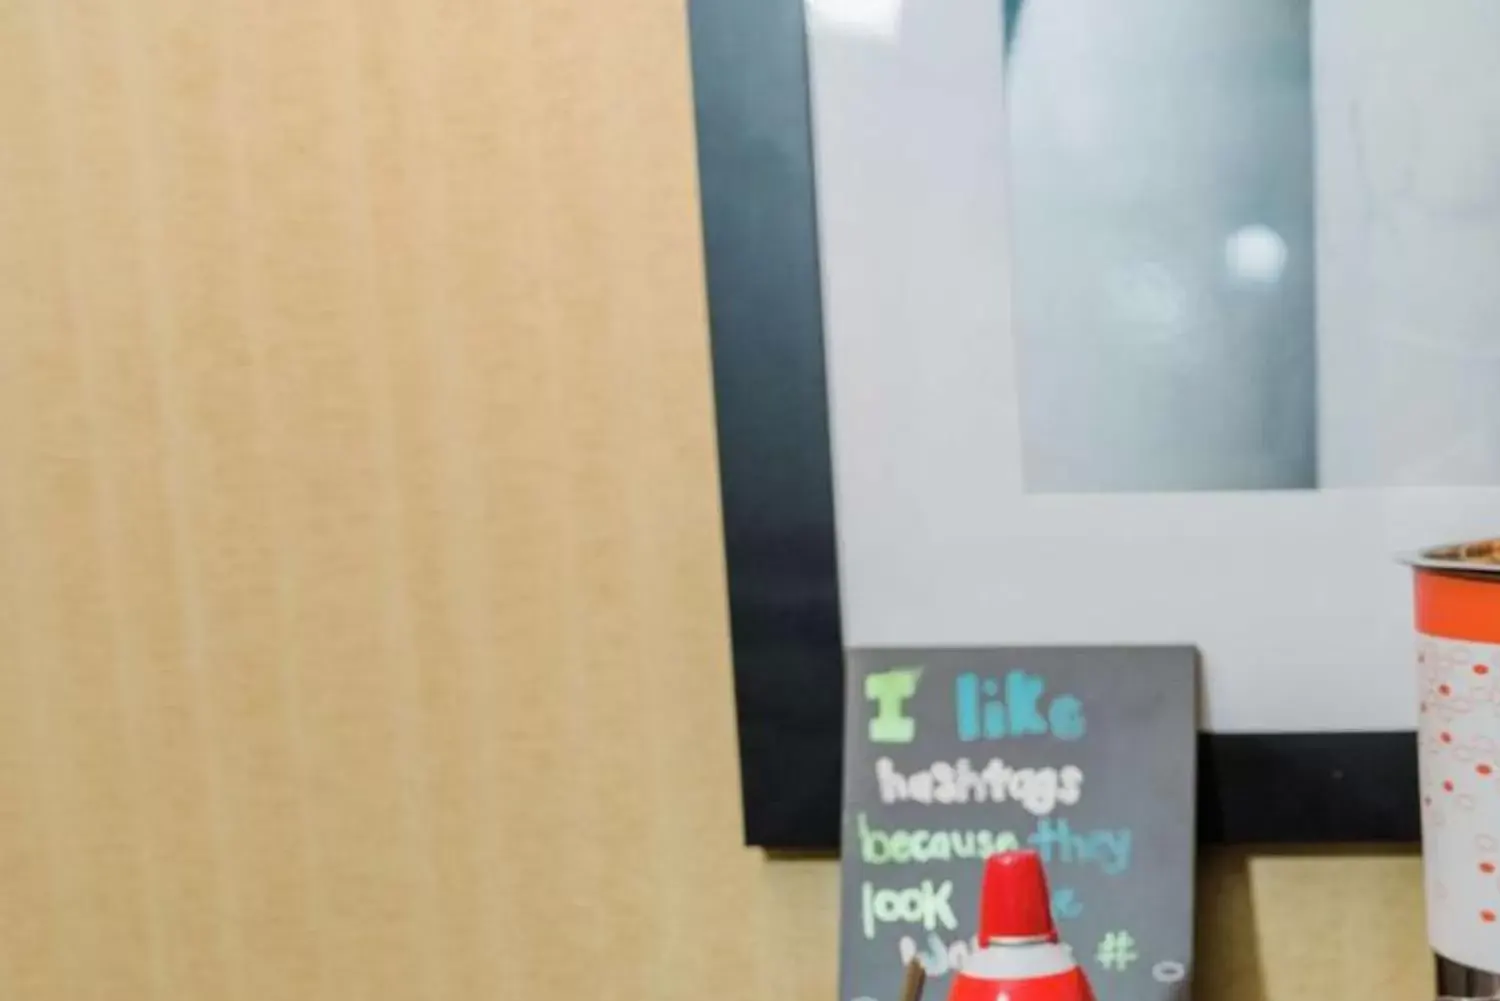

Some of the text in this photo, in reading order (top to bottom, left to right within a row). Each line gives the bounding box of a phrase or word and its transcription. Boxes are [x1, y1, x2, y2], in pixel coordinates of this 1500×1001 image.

[865, 666, 1086, 743] I like
[875, 756, 1084, 815] hashtags
[861, 879, 957, 939] look
